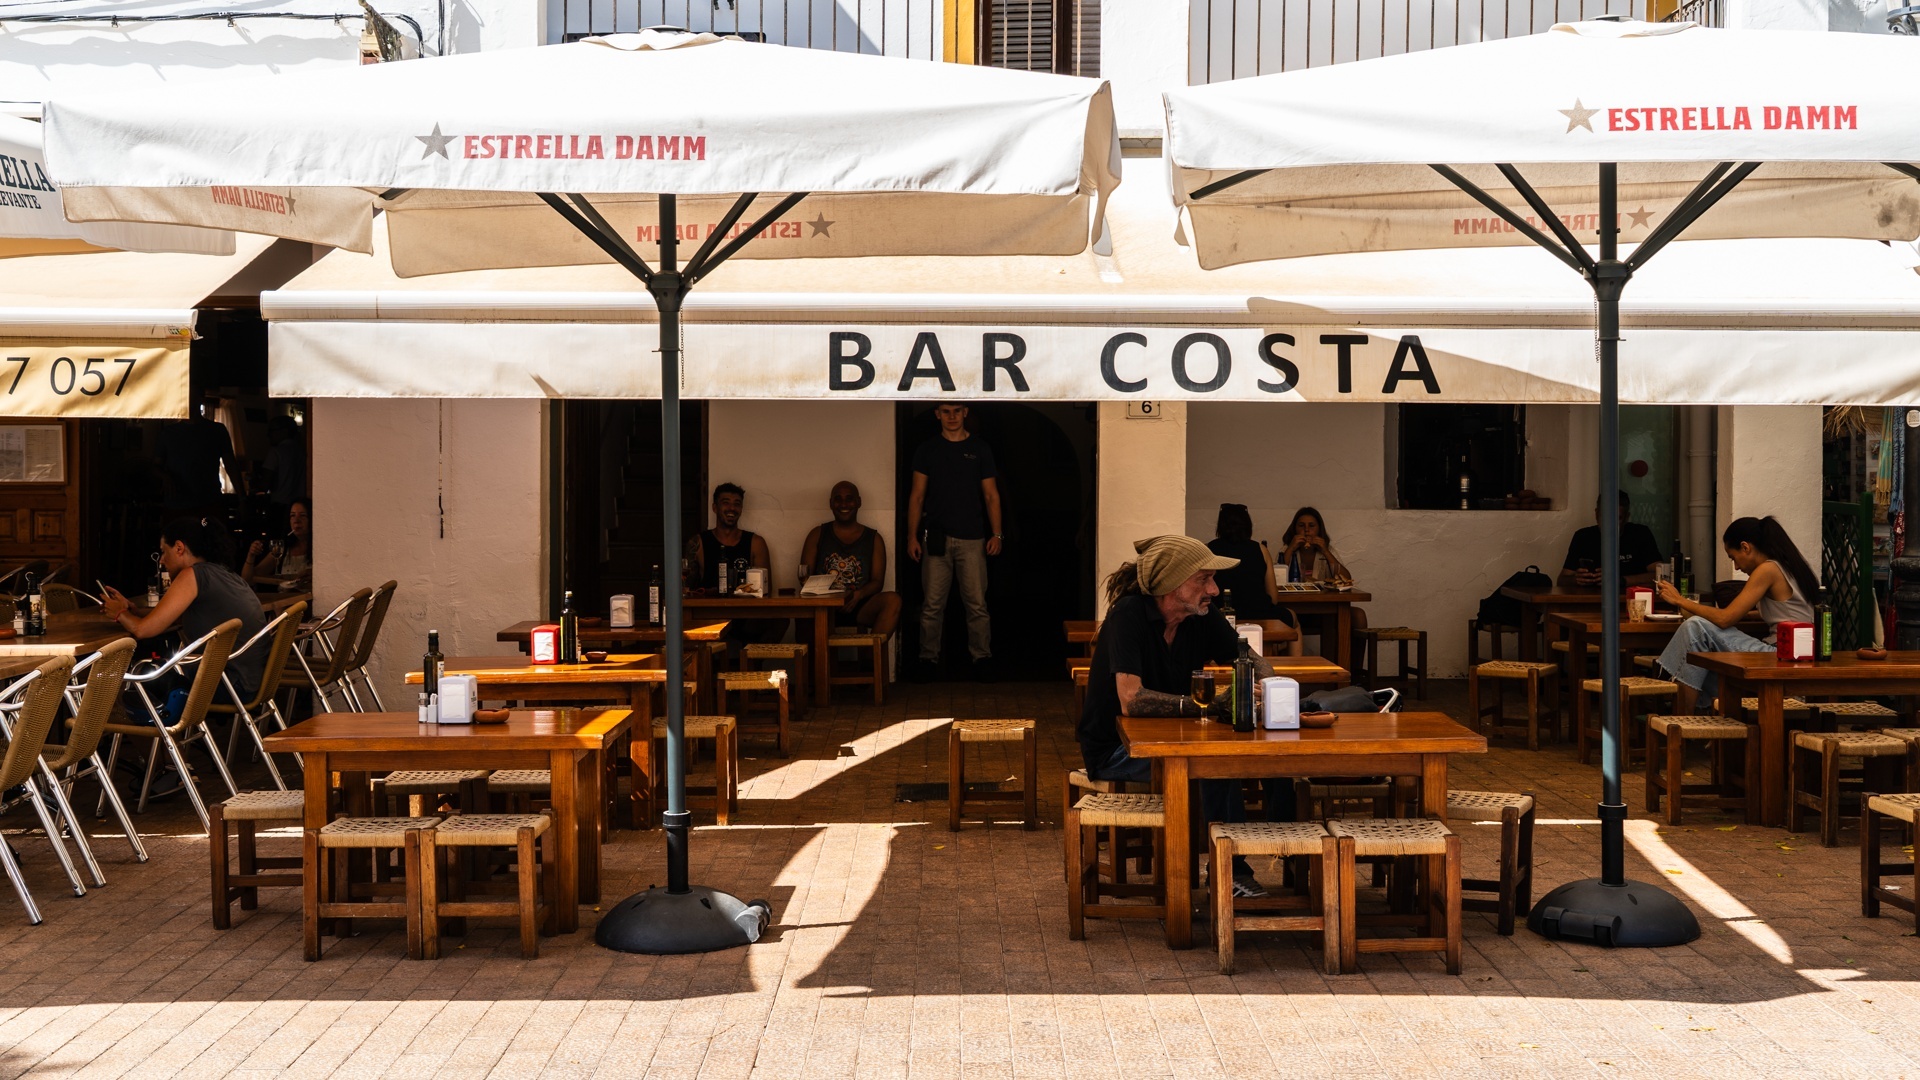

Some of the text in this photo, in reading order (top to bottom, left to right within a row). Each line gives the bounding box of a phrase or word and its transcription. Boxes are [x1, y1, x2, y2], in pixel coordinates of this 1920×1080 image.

[1608, 105, 1858, 132] ESTRELLA DAMM
[464, 135, 706, 161] ESTRELLA DAMM
[0, 154, 56, 192] ELLA
[50, 357, 137, 397] 057
[829, 332, 1442, 395] BAR COSTA
[1141, 400, 1153, 414] 6
